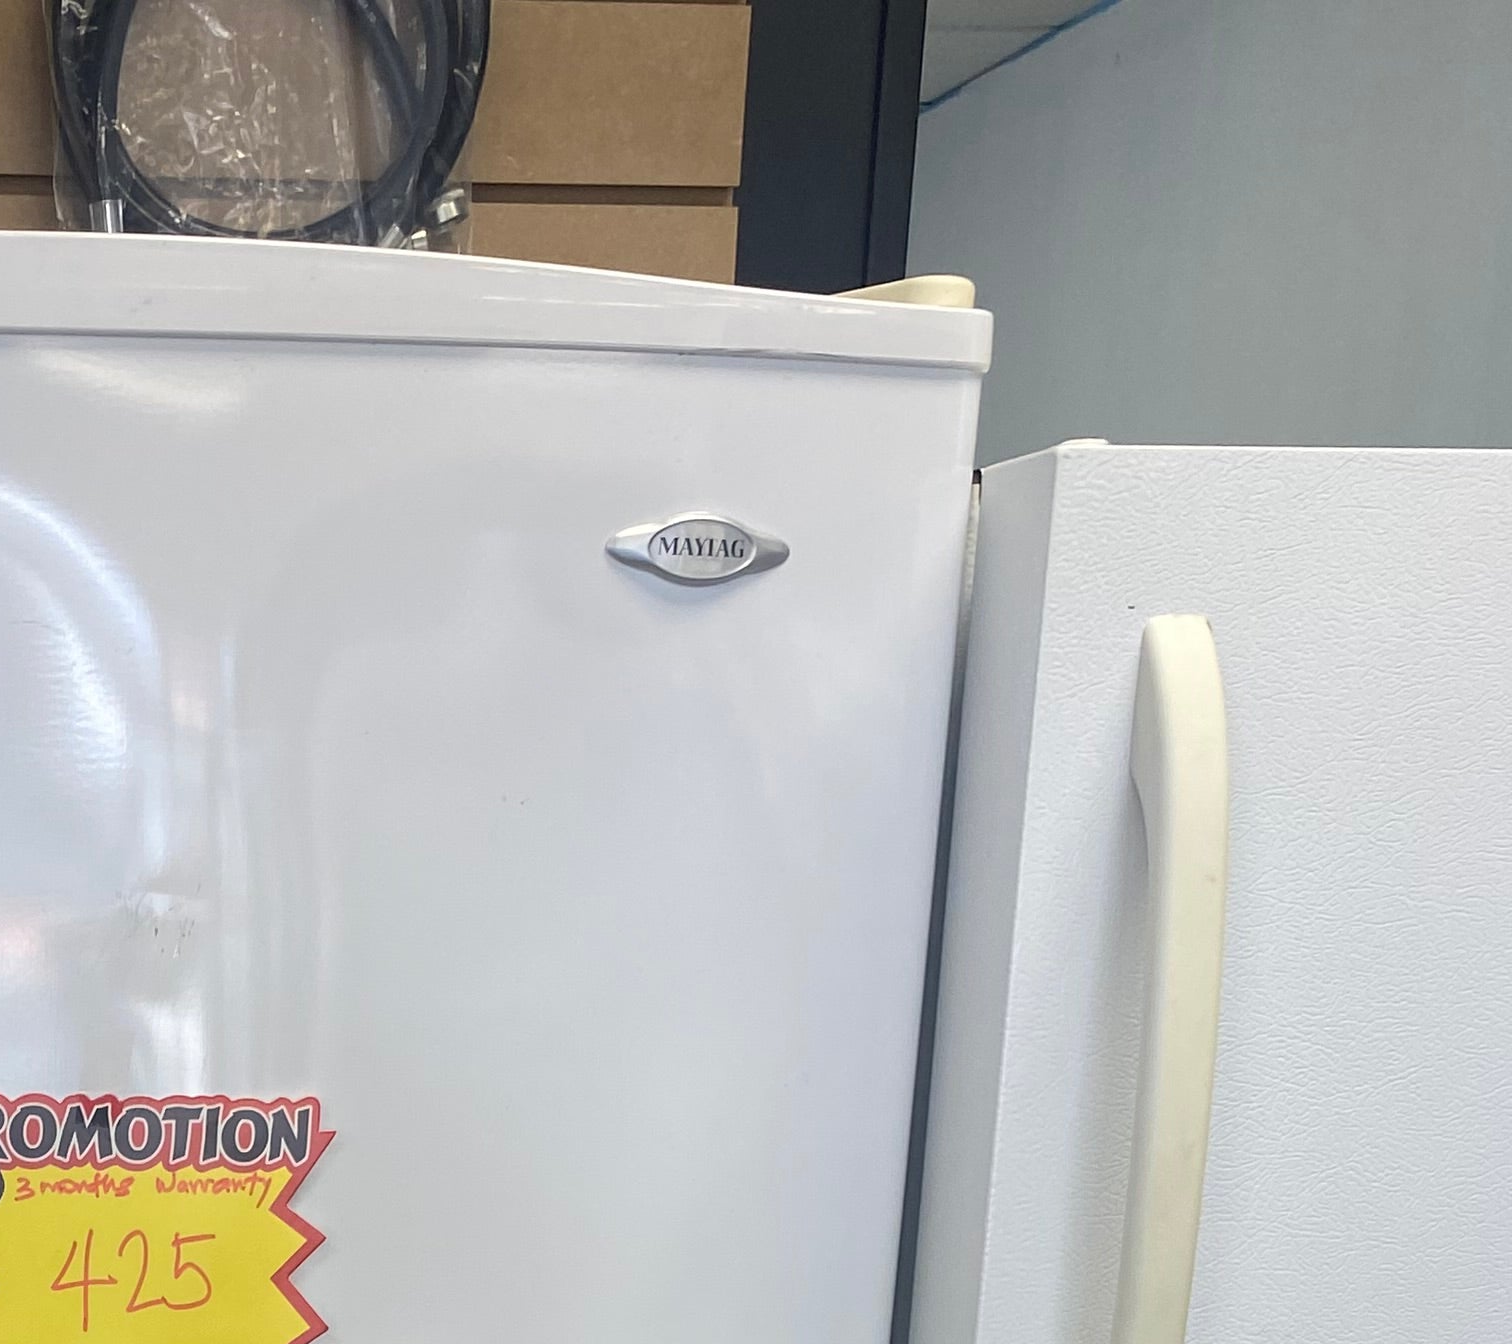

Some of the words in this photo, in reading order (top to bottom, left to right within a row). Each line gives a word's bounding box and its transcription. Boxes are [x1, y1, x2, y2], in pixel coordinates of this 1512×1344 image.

[658, 536, 745, 559] MAYTAG
[13, 1177, 36, 1202] 3
[39, 1172, 136, 1198] months
[50, 1228, 217, 1333] 425
